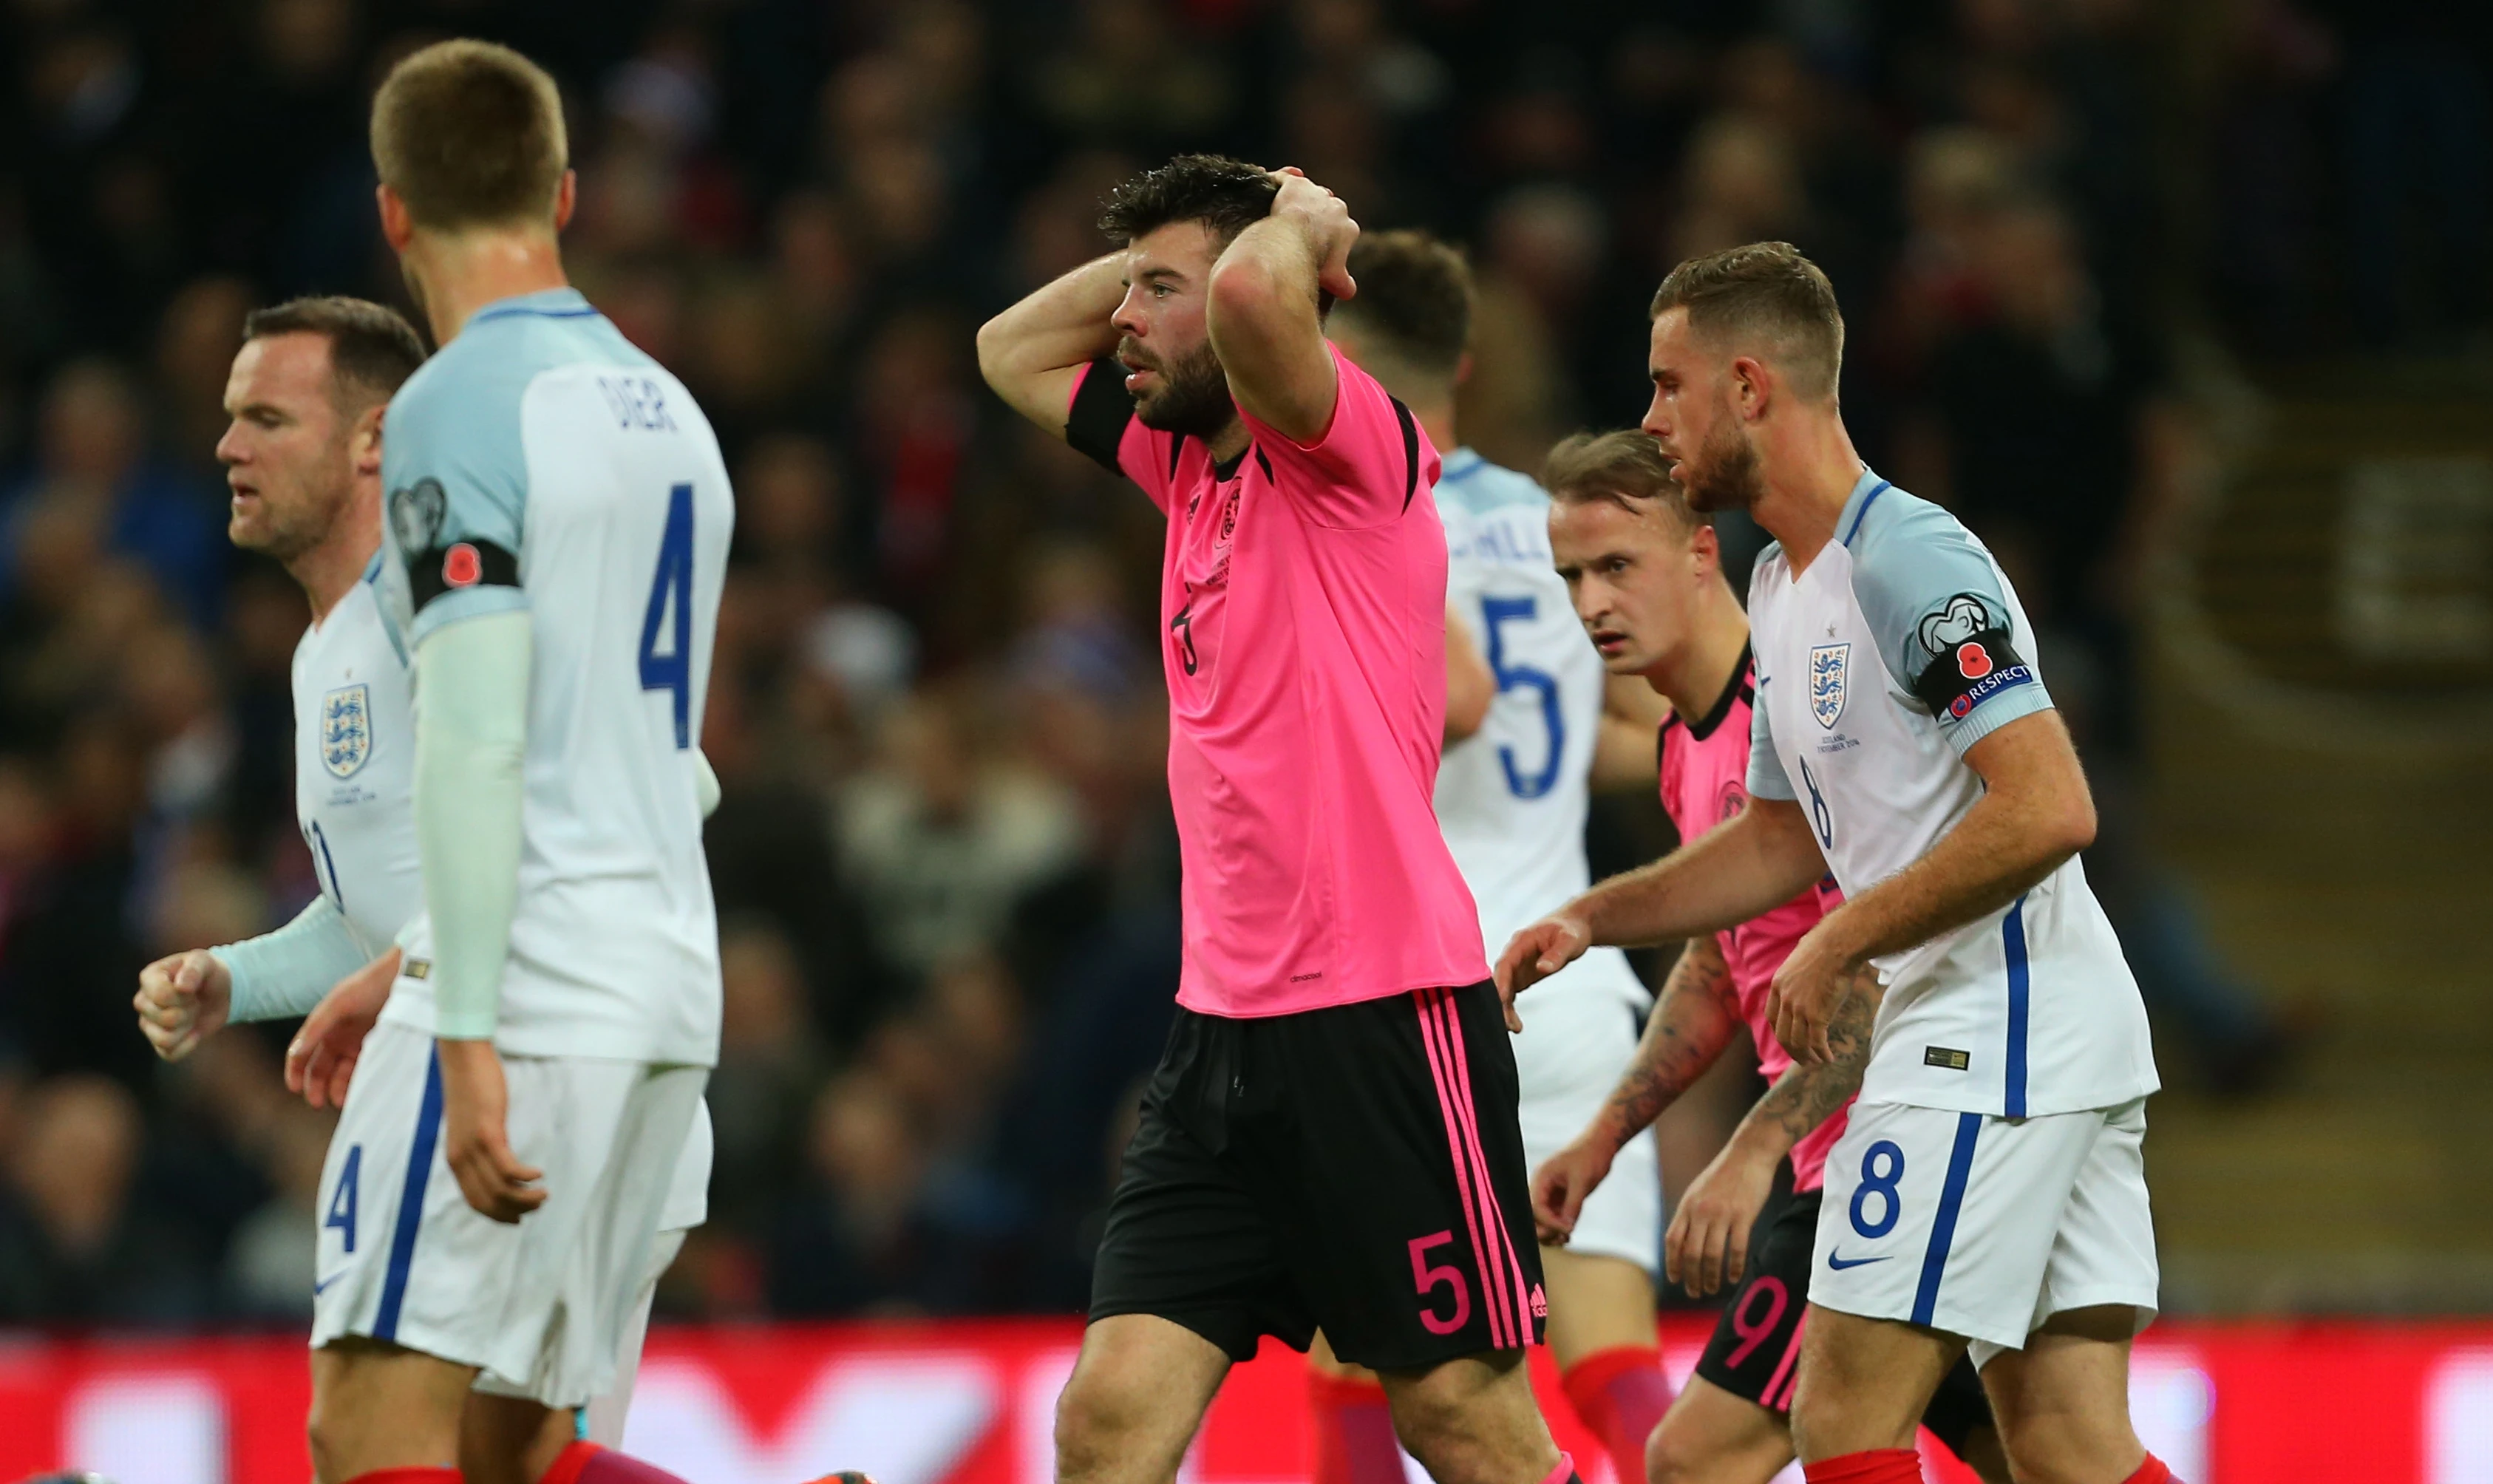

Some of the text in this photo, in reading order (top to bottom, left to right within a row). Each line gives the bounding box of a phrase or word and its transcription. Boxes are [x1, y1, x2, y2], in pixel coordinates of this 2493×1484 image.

[596, 375, 678, 432] DIER
[637, 483, 695, 749] 4
[1480, 594, 1566, 800] 5
[1968, 665, 2029, 700] RESPECT
[1799, 754, 1832, 850] 8
[325, 1146, 361, 1254] 4
[1849, 1140, 1905, 1239] 8
[1408, 1229, 1472, 1335] 5
[1724, 1275, 1789, 1370] 9
